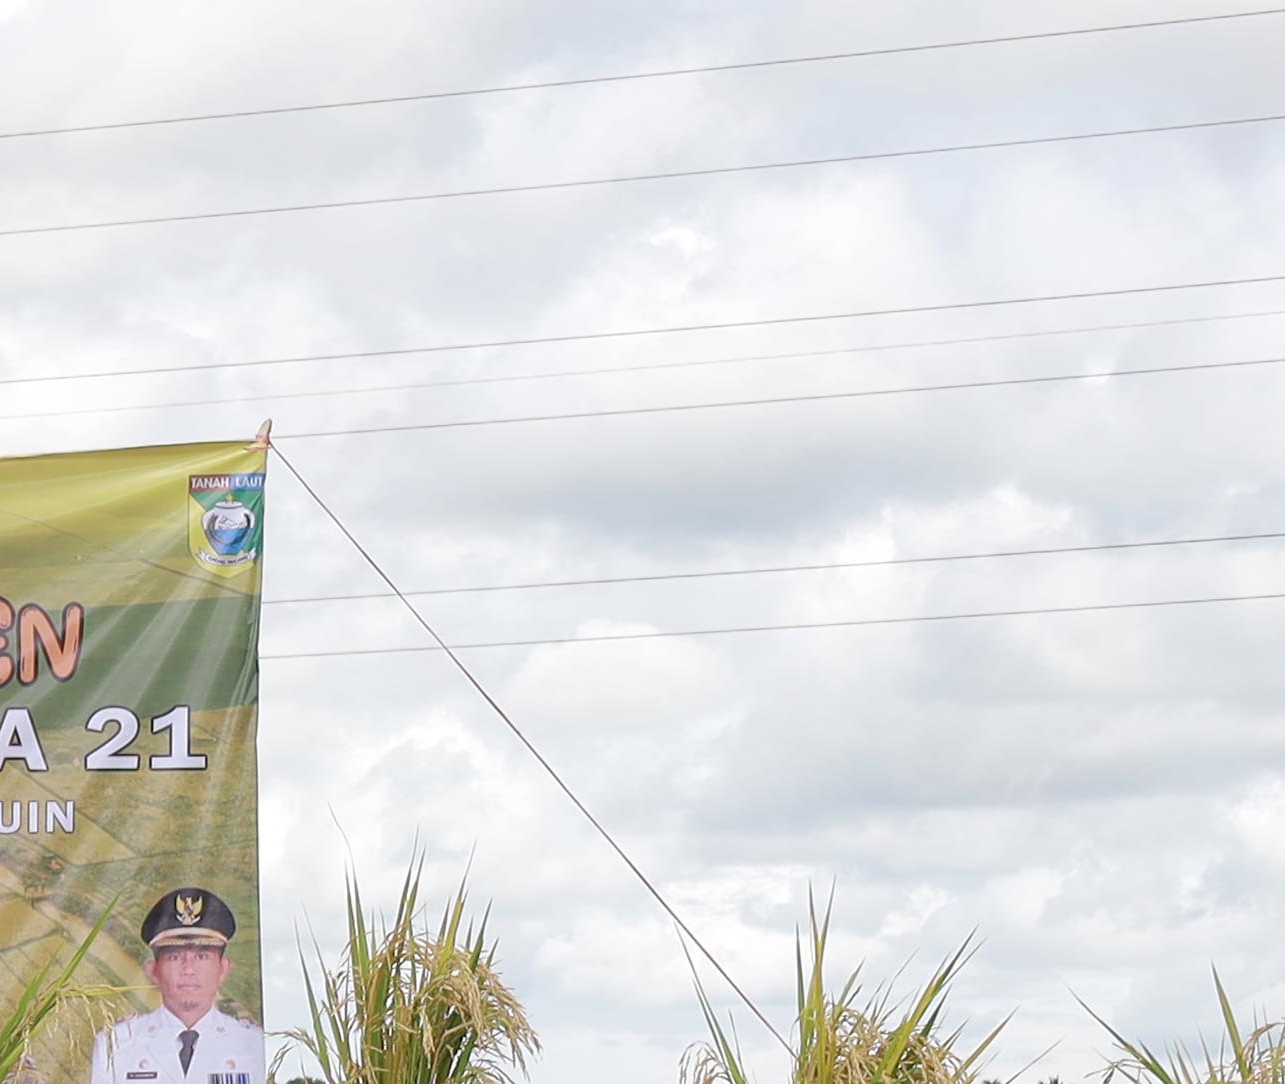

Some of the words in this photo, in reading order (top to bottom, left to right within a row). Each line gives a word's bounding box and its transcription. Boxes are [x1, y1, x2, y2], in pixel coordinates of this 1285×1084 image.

[191, 476, 229, 488] TANAH
[235, 475, 263, 488] LAUT
[85, 706, 208, 771] 21
